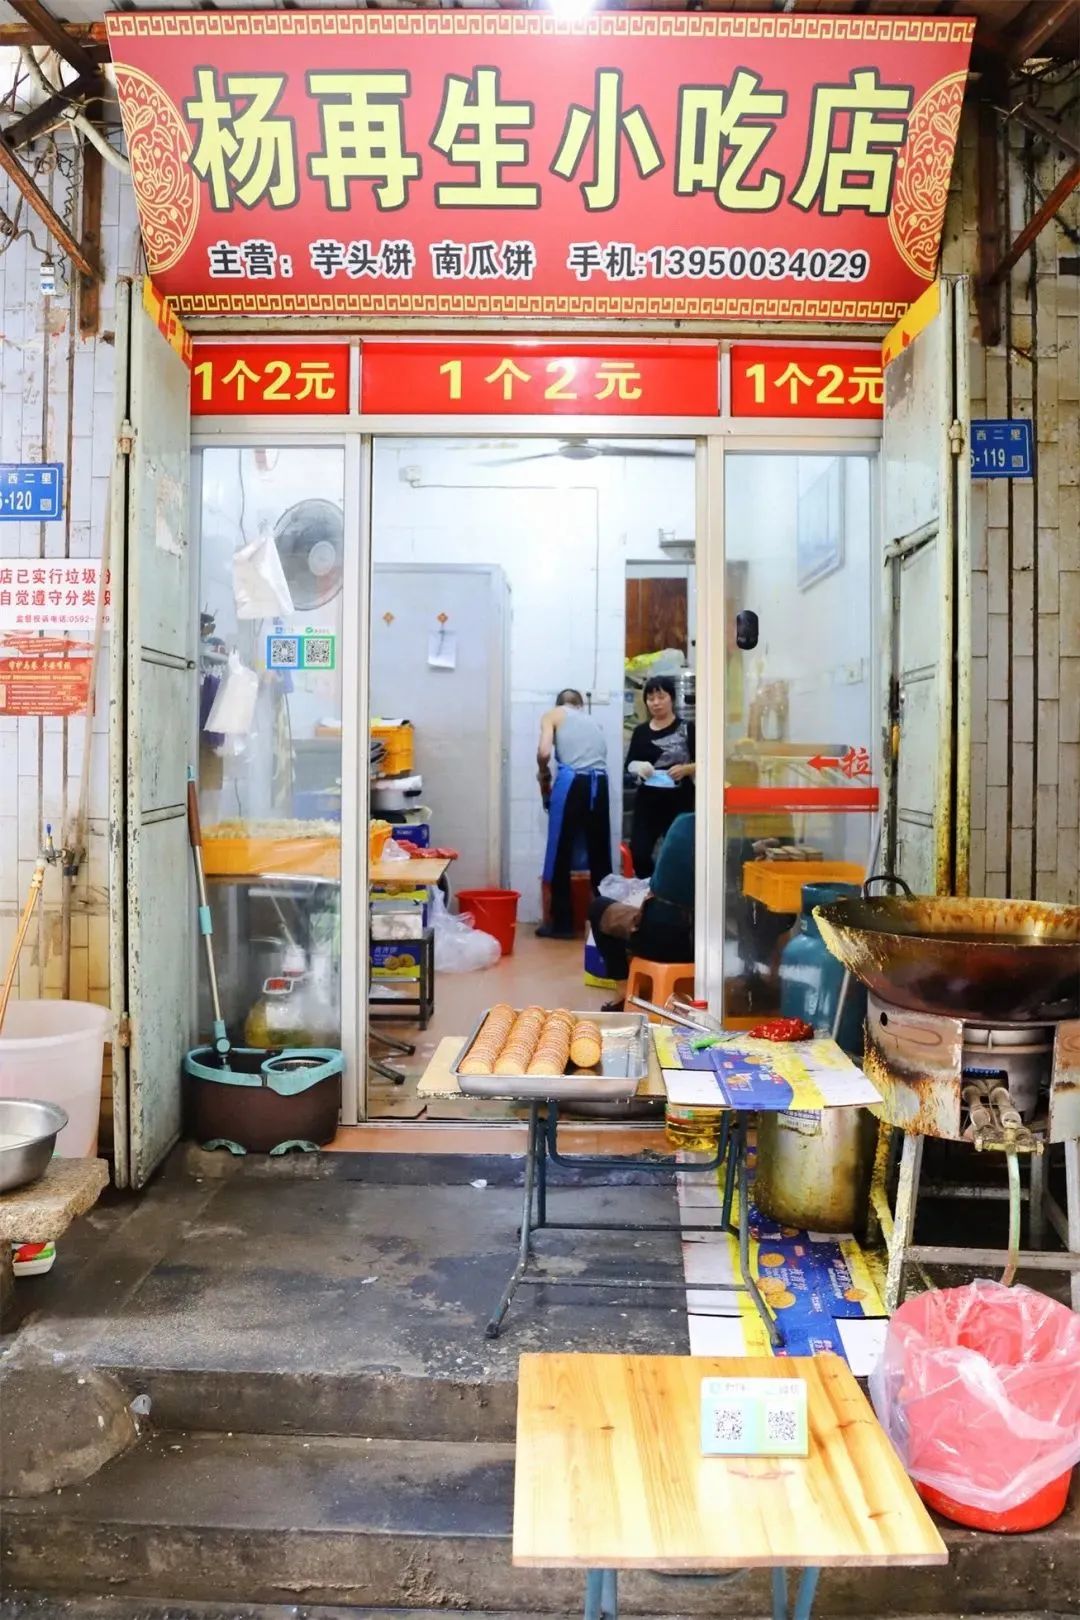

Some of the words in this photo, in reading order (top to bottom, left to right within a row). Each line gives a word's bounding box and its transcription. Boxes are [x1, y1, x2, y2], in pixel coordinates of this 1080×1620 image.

[184, 66, 912, 214] 杨再生小吃店
[313, 243, 412, 276] 芋头饼
[432, 243, 533, 277] 南瓜饼
[570, 245, 868, 279] 手机:13950034029
[194, 359, 336, 401] 1个2元
[745, 362, 884, 405] 1个2元
[0, 472, 52, 485] 西二里
[839, 745, 873, 779] 拉
